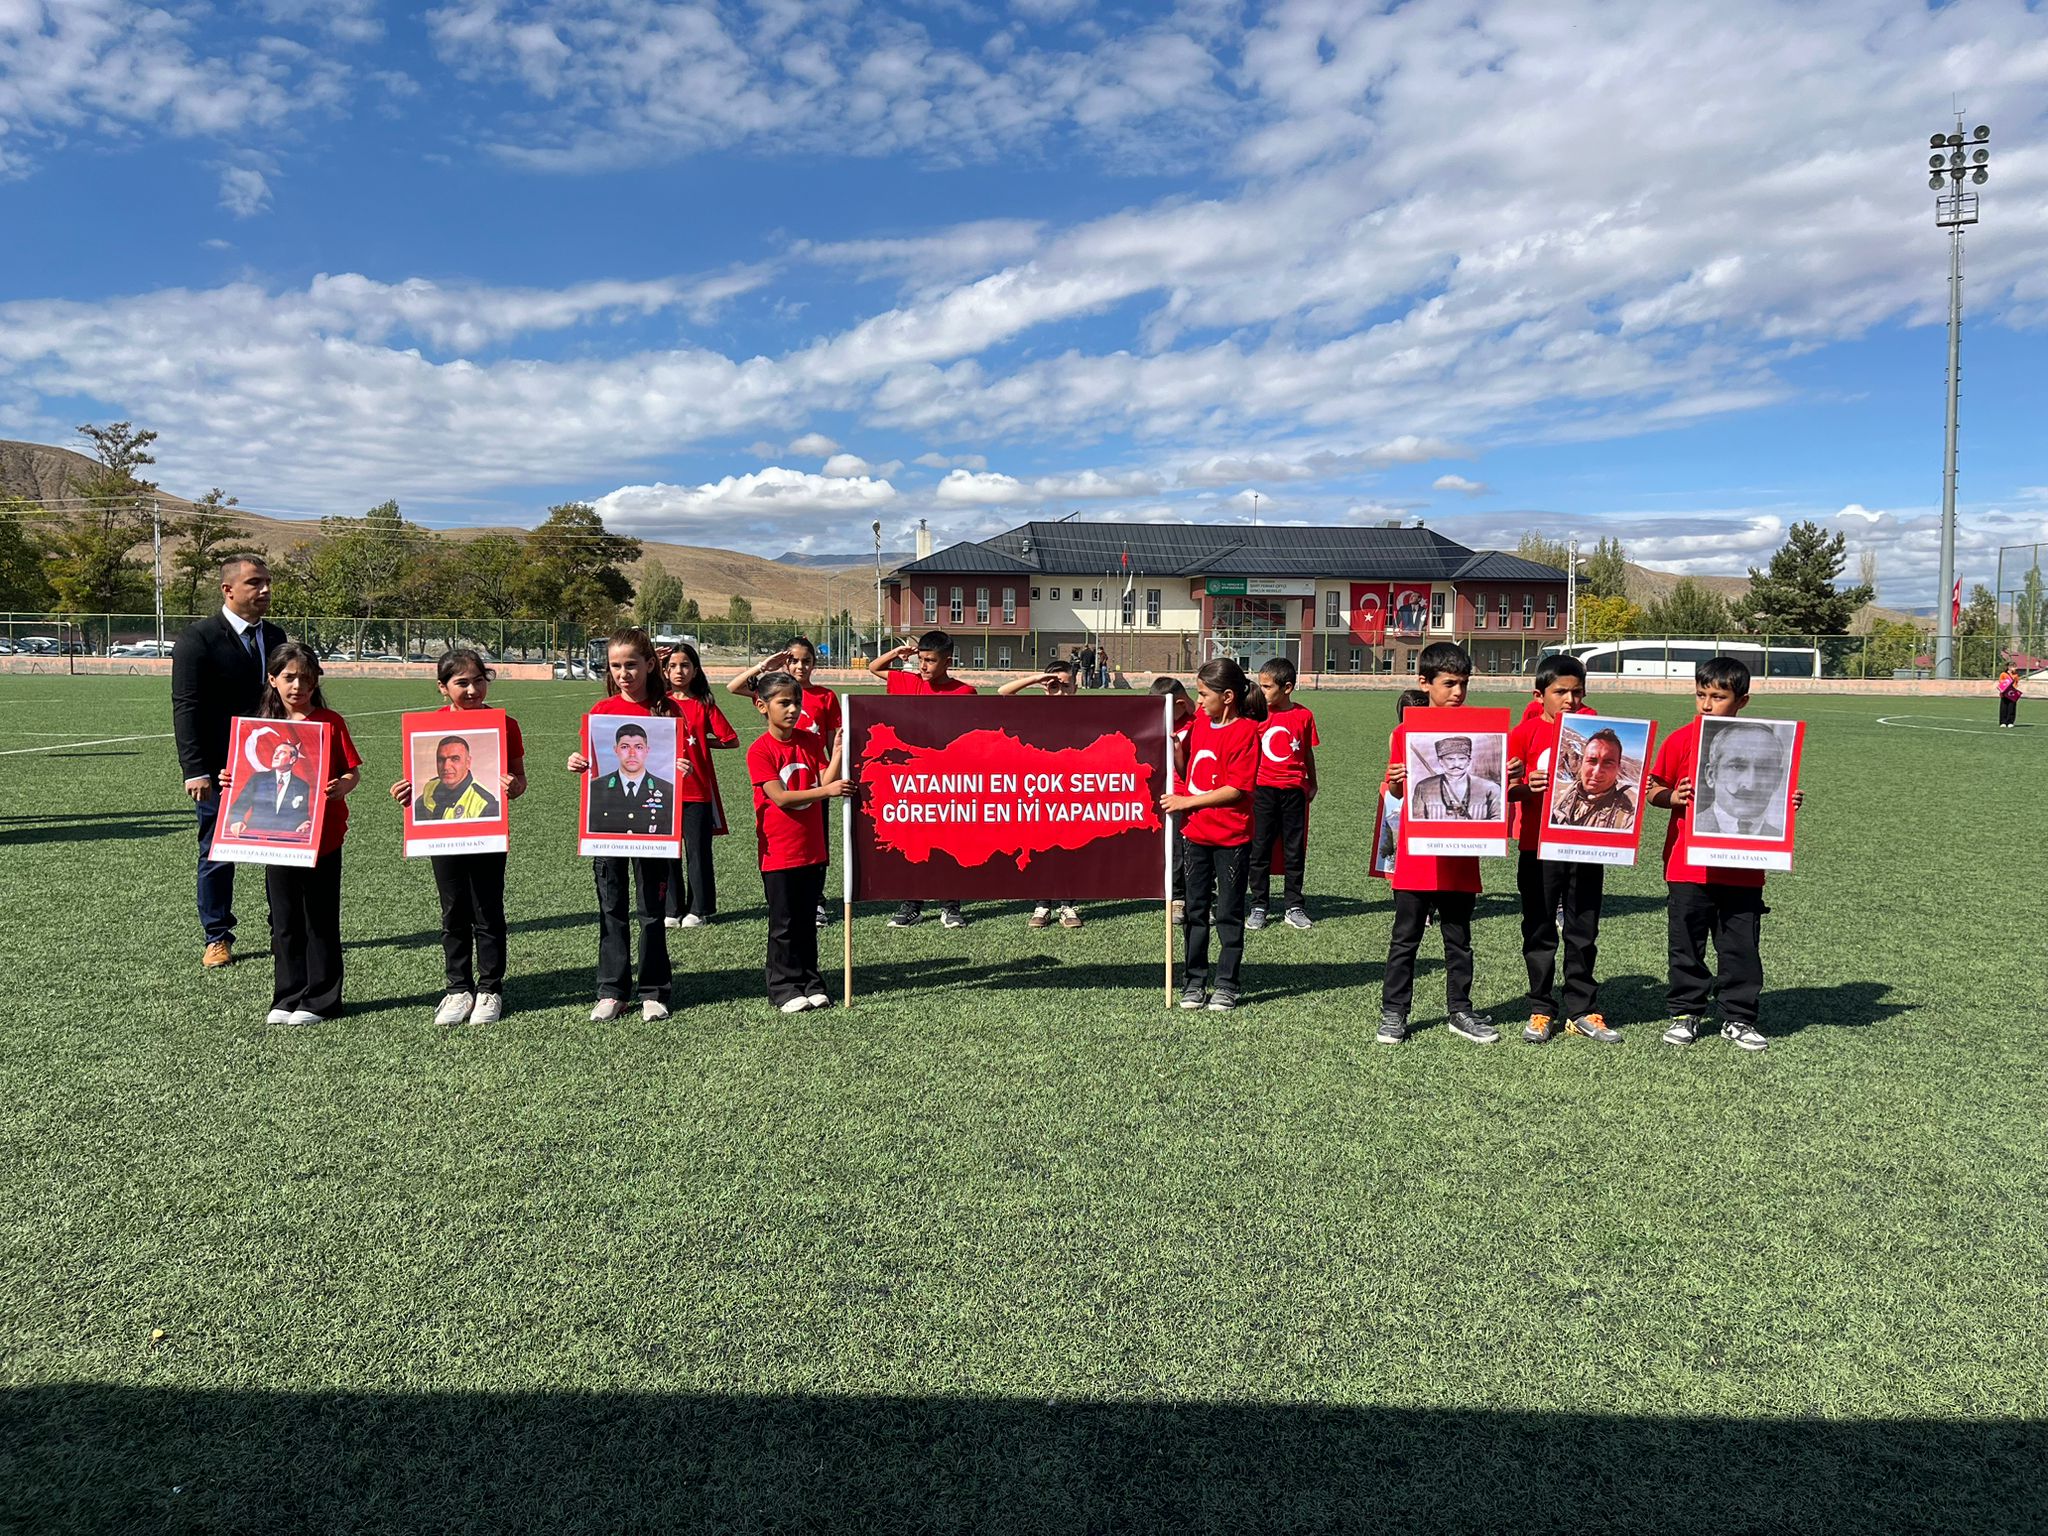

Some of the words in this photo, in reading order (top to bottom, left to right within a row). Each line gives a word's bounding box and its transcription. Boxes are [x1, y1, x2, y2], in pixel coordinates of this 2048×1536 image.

[891, 773, 983, 794] VATANINI
[990, 773, 1017, 793] EN
[1023, 773, 1063, 797] ÇOK
[1070, 773, 1135, 792] SEVEN
[882, 799, 977, 823] GÖREVİNİ
[983, 803, 1010, 823] EN
[1017, 798, 1039, 822] İYİ
[1045, 802, 1143, 822] YAPANDIR
